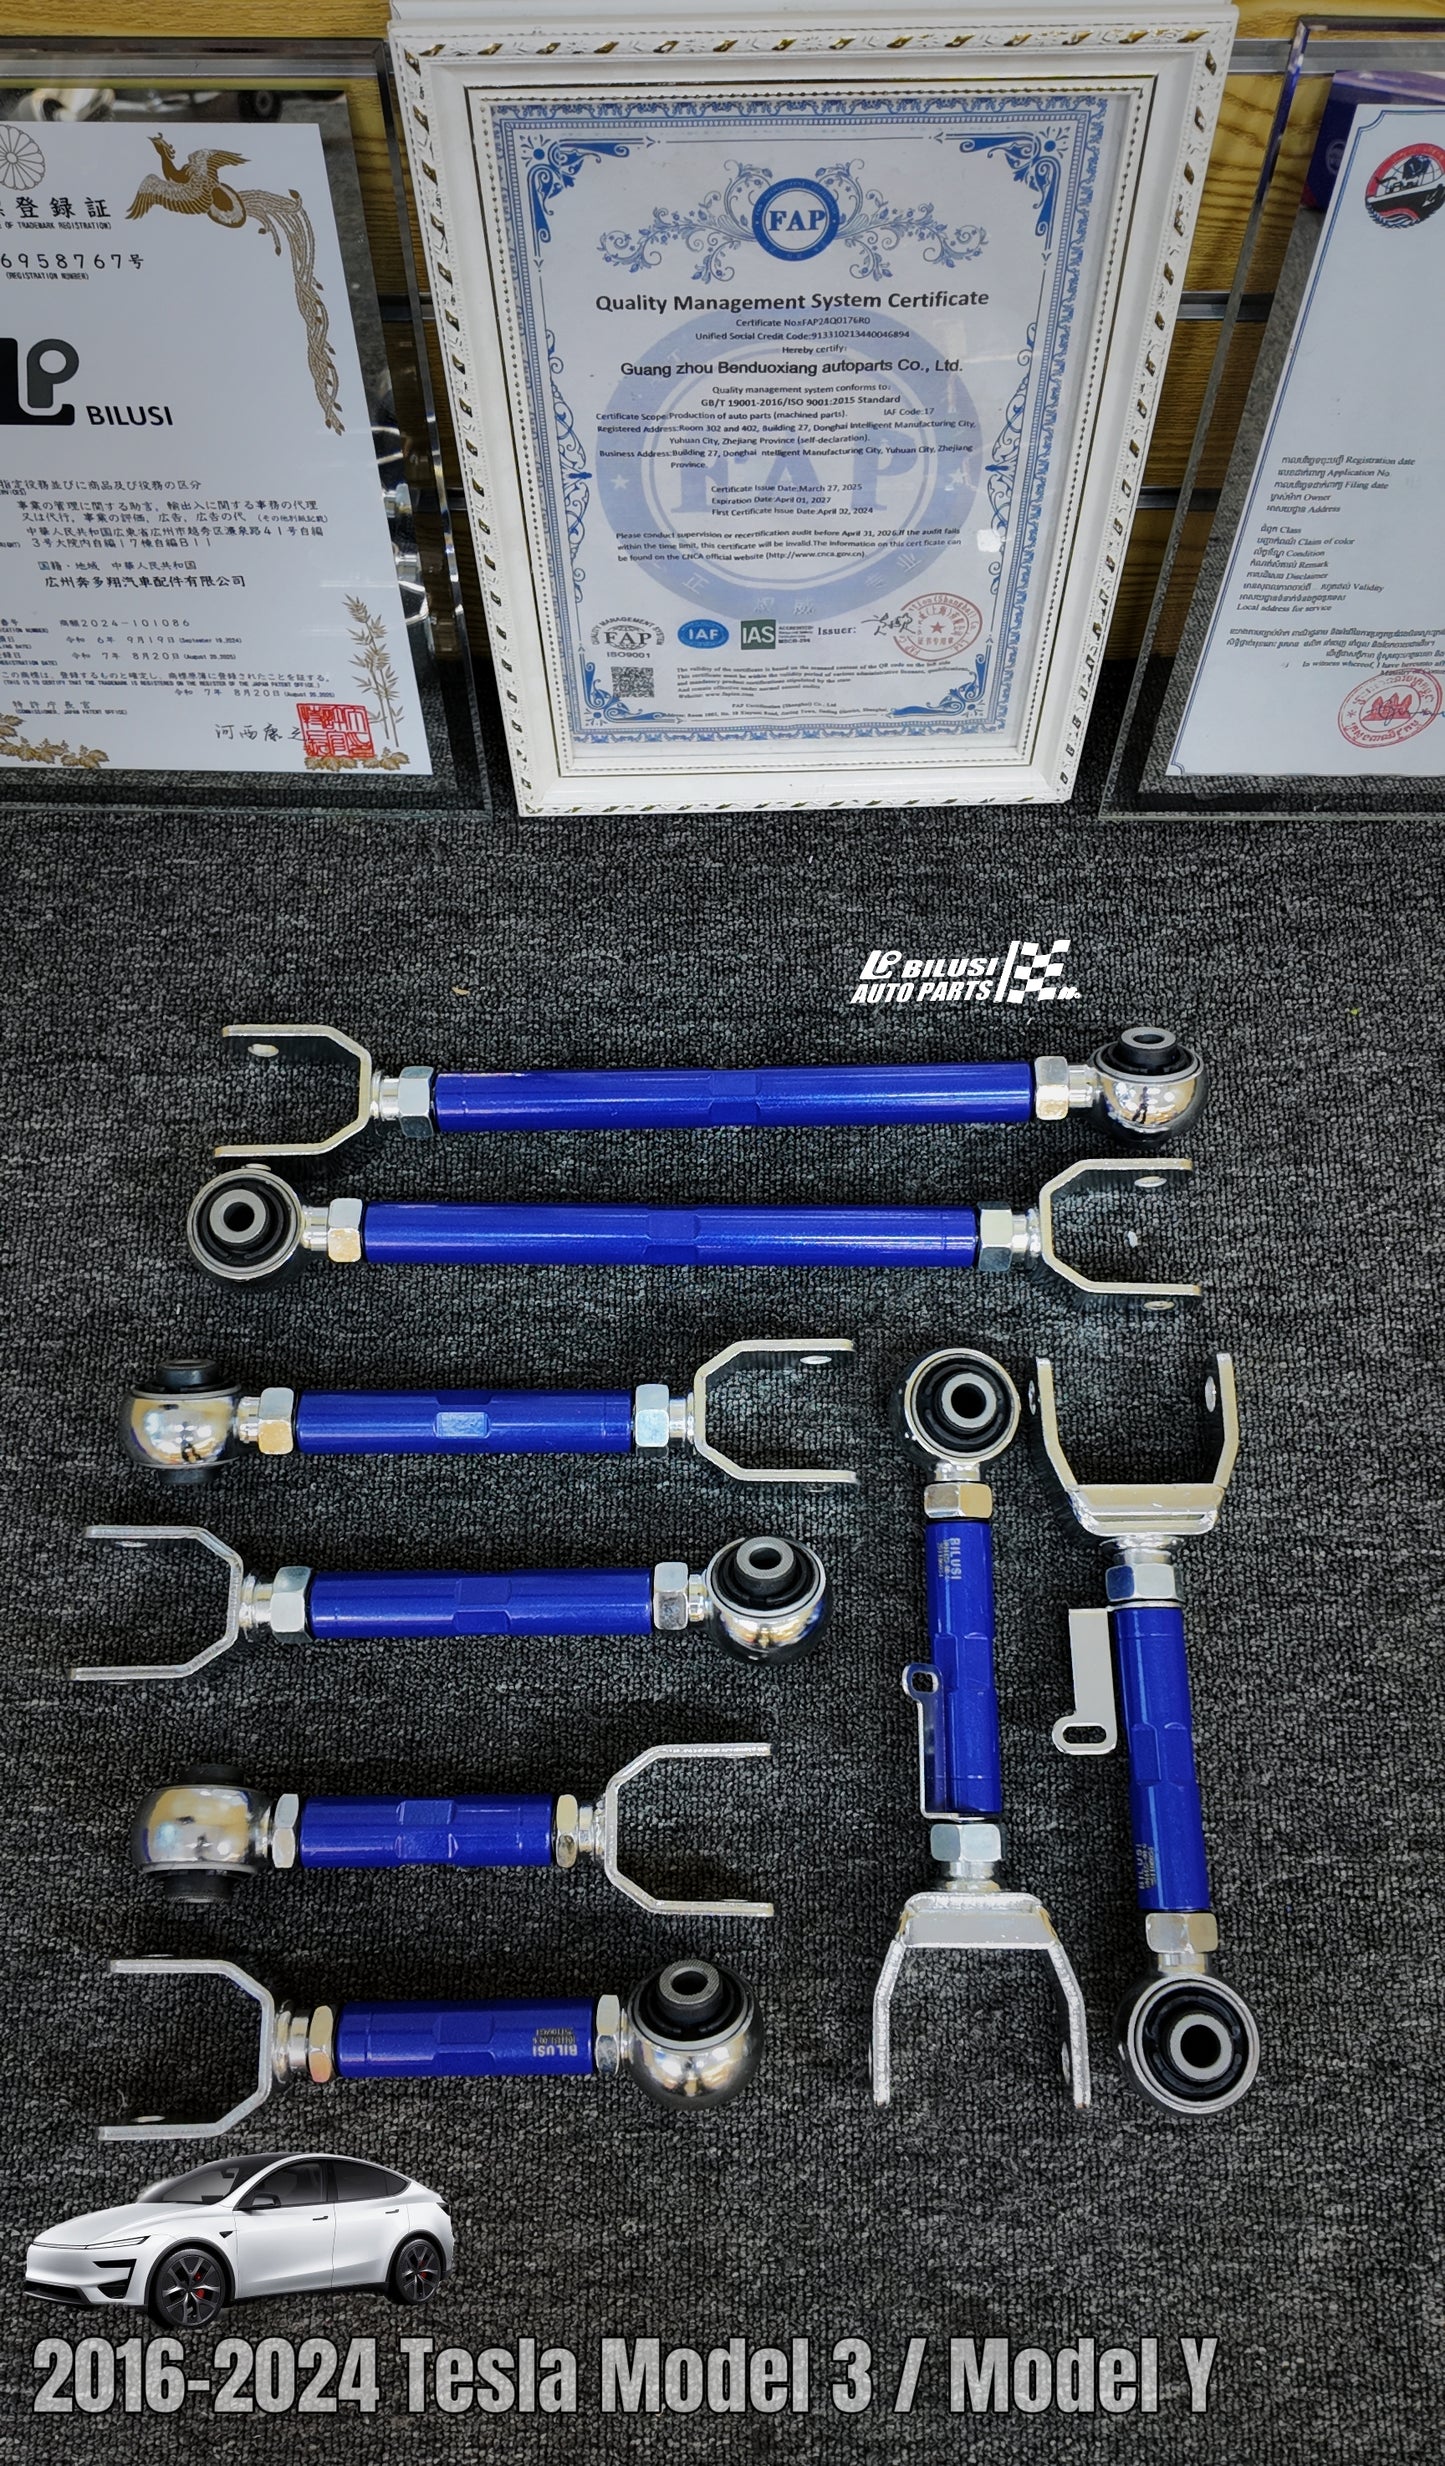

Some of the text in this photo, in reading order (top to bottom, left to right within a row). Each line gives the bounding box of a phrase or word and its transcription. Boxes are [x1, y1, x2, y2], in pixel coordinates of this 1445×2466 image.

[0, 196, 111, 219] 登録証
[18, 221, 112, 230] TRADEMARK REGISTRATION)
[768, 209, 826, 232] FAP
[6, 271, 90, 281] (REGISTRATION NUMBER)
[595, 290, 990, 315] Quality Management System Certificate
[735, 318, 782, 327] Certificate
[695, 331, 728, 341] Unified
[729, 331, 756, 341] Social
[757, 331, 785, 341] Credit
[781, 343, 848, 356] Hereby certify:
[620, 358, 964, 378] Guang zhou Benduoxiang autoparts Co., Ltd.
[711, 383, 892, 396] Quality management system conforms to:
[700, 394, 901, 408] GB/T 19001-2016/ISO 9001:2015 Standard
[86, 405, 174, 426] BILUSI
[595, 412, 640, 421] Certificate
[728, 412, 748, 421] auto
[749, 412, 772, 422] parts
[773, 410, 819, 421] (machined
[820, 409, 848, 421] parts).
[883, 408, 897, 416] IAF
[597, 425, 642, 434] Registered
[706, 424, 722, 432] 302
[723, 424, 740, 433] and
[741, 424, 760, 434] 402,
[762, 423, 797, 433] Building
[813, 422, 849, 433] Donghai
[850, 421, 893, 431] Intelligent
[894, 419, 957, 429] Manufacturing
[669, 437, 701, 445] Yuhuan
[721, 437, 758, 447] Zhejiang
[759, 436, 796, 445] Province
[599, 443, 974, 458] Business Donghai ntelligent Manufacturing Yuhuan Zhejiang
[1345, 455, 1396, 466] Registration
[1397, 457, 1416, 466] date
[1326, 468, 1375, 479] Application
[1376, 468, 1391, 478] No
[710, 485, 754, 493] Certificate
[754, 484, 776, 492] Issue
[842, 482, 863, 491] 2025
[1344, 480, 1370, 490] Filing
[1370, 481, 1390, 490] date
[711, 496, 753, 505] Expiration
[810, 496, 832, 505] 2027
[1303, 493, 1332, 502] Owner
[711, 506, 875, 517] First Certificate Issue 2024
[1308, 505, 1341, 514] Address
[616, 527, 961, 540] Please conduct supervision recertification audit before April the audit fails
[1279, 525, 1302, 534] Class
[617, 542, 642, 550] within
[658, 542, 678, 550] time
[678, 542, 700, 551] limit,
[700, 541, 716, 550] this
[717, 541, 757, 550] certificate
[757, 540, 773, 548] will
[773, 540, 784, 548] be
[828, 539, 876, 548] information
[889, 539, 905, 547] this
[905, 538, 946, 548] certficate
[947, 538, 962, 546] can
[1298, 537, 1322, 546] Claim
[1334, 537, 1356, 545] color
[617, 554, 629, 562] be
[630, 553, 653, 561] found
[666, 553, 681, 561] the
[681, 552, 705, 561] CNCA
[705, 553, 733, 562] official
[733, 552, 765, 561] website
[1285, 549, 1326, 558] Condition
[1298, 560, 1329, 569] Remark
[1284, 571, 1329, 580] Disclaimer
[1353, 583, 1385, 593] Validity
[1236, 603, 1333, 613] Local address for service
[599, 616, 656, 629] MANAGEMENT
[687, 628, 720, 641] IAF
[741, 625, 776, 645] IAS
[817, 626, 857, 636] Issuer:
[604, 631, 653, 646] FAP
[606, 651, 651, 659] ISO9001
[949, 1537, 962, 1581] BILUSI
[532, 2044, 578, 2058] BILUSI
